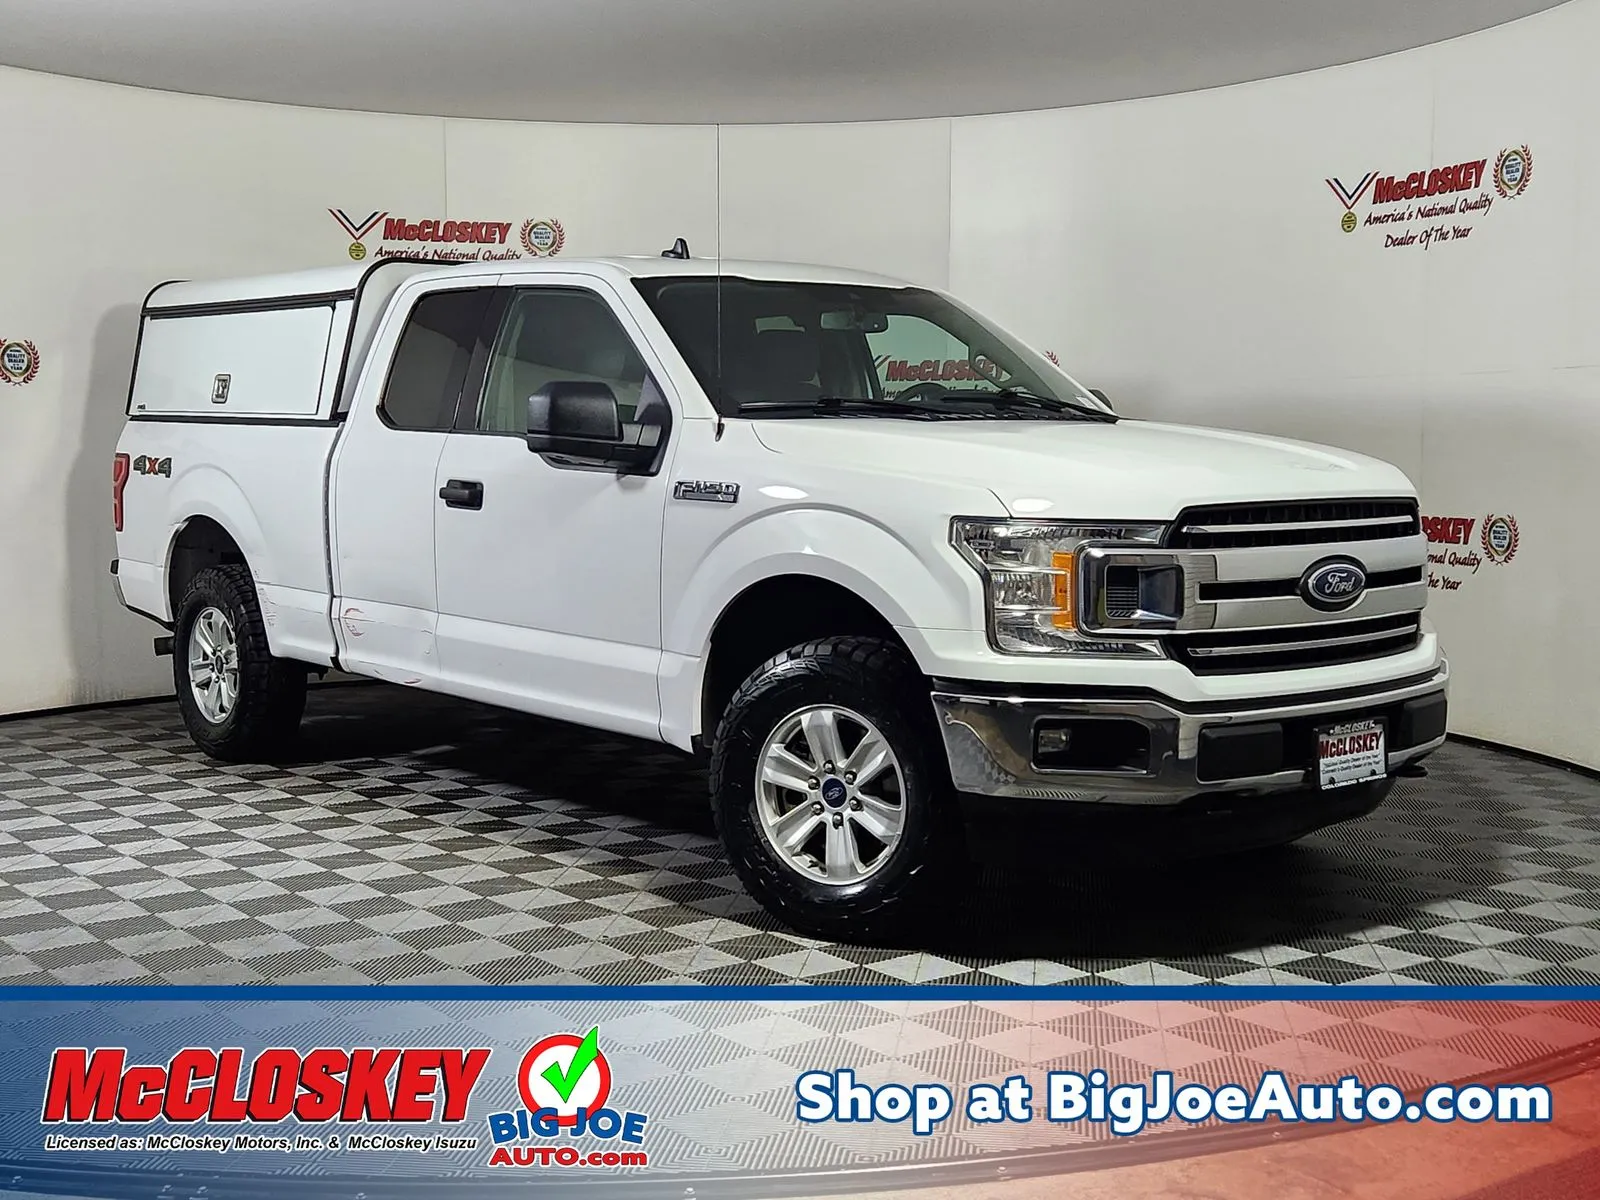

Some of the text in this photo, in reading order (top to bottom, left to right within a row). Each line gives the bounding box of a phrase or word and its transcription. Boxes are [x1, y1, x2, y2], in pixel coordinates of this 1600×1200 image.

[1372, 159, 1487, 204] McCLOSKEY
[1364, 204, 1413, 227] America's
[1415, 197, 1459, 220] National
[1460, 192, 1494, 216] Quality
[383, 218, 512, 244] McCLOSKEY
[1384, 224, 1473, 250] Dealer Of The Year
[374, 245, 429, 259] America's
[432, 248, 481, 260] National
[1448, 550, 1482, 574] Quality
[1324, 572, 1356, 594] Ford
[1441, 576, 1462, 590] Year
